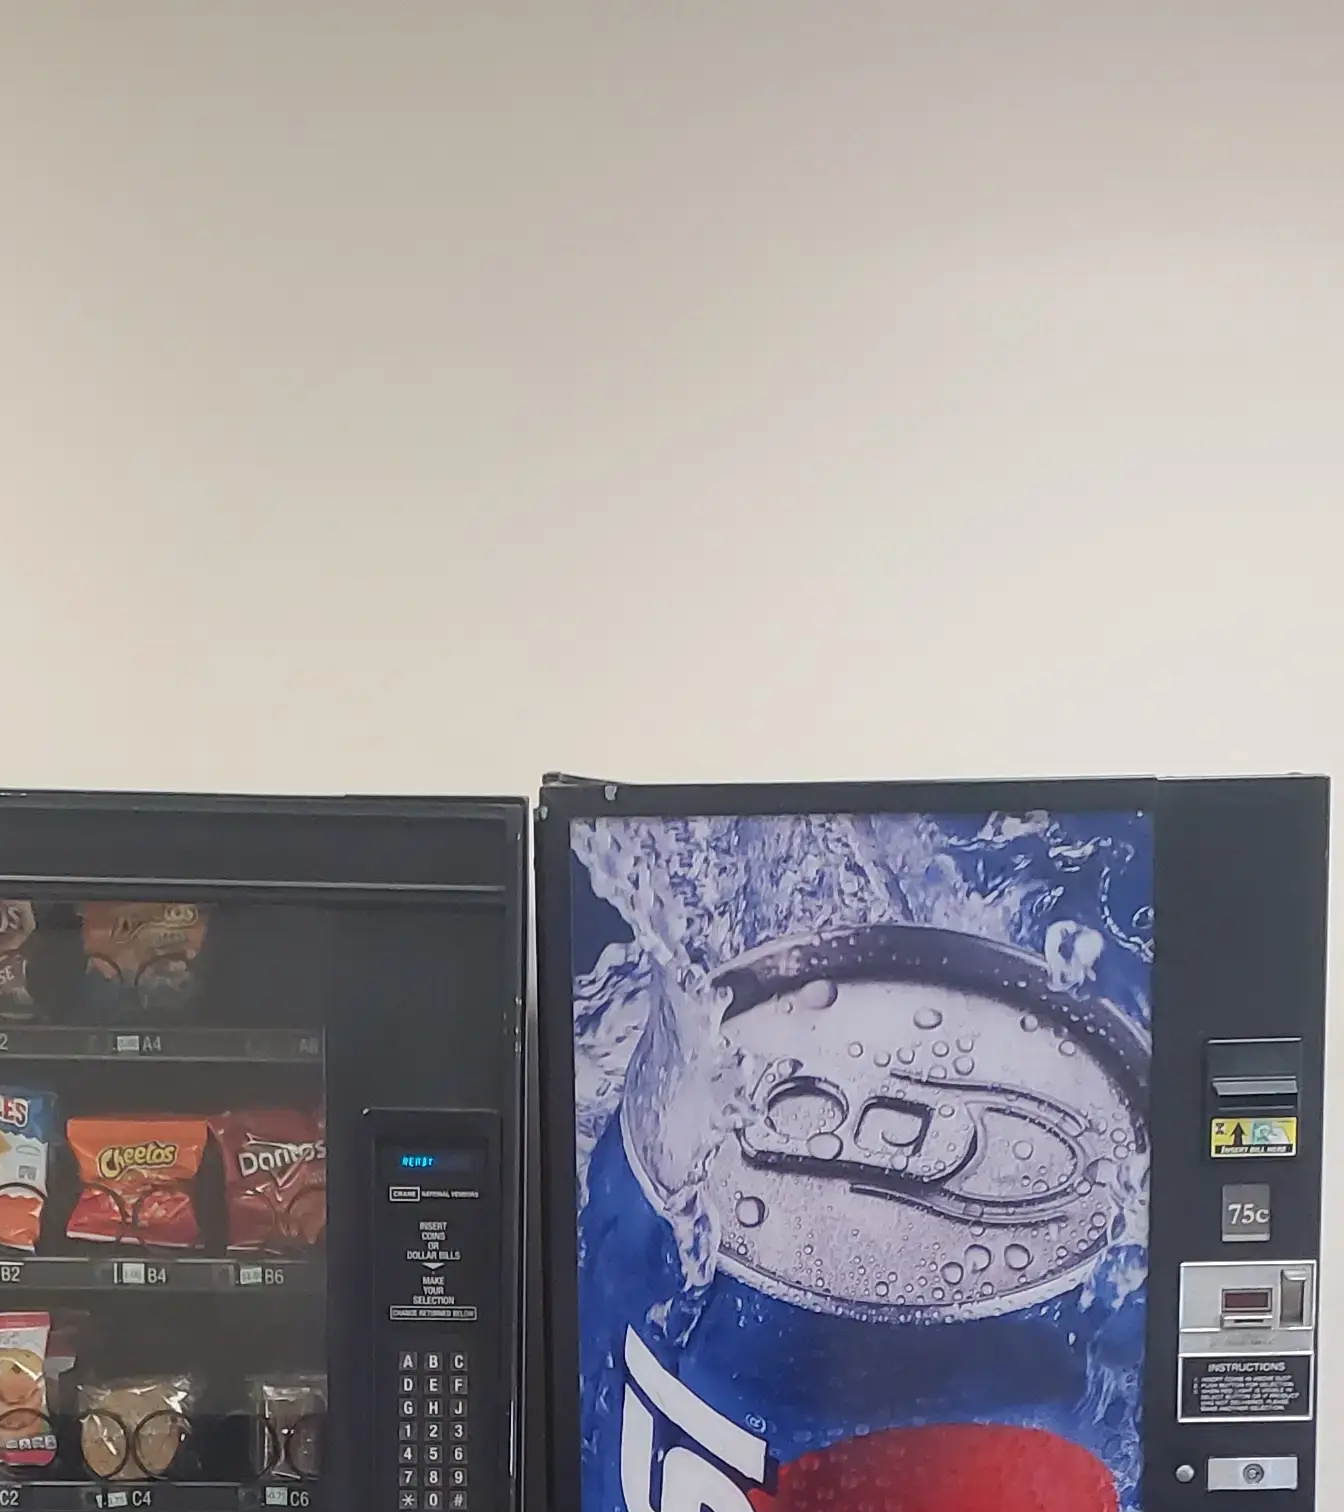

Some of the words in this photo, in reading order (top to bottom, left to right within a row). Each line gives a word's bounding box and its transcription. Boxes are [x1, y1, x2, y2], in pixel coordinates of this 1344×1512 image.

[142, 1036, 162, 1052] A4
[98, 1142, 178, 1179] Cheetos
[238, 1141, 327, 1177] Doritos
[401, 1155, 435, 1168] READY
[419, 1221, 447, 1231] INSERT
[421, 1231, 446, 1241] COINS
[427, 1241, 440, 1251] OR
[406, 1250, 437, 1261] DOLLAR
[438, 1251, 461, 1261] BILLS
[0, 1266, 21, 1282] B2
[147, 1268, 167, 1284] B4
[264, 1269, 284, 1285] B6
[422, 1276, 445, 1286] MAKE
[423, 1286, 444, 1296] YOUR
[412, 1296, 455, 1306] SELECTION
[403, 1354, 414, 1369] A
[428, 1354, 439, 1369] B
[454, 1354, 464, 1369] C
[1207, 1361, 1286, 1373] INSTRUCTIONS
[403, 1377, 414, 1392] D
[428, 1377, 439, 1392] E
[454, 1377, 464, 1392] F
[403, 1401, 414, 1415] G
[428, 1401, 439, 1415] H
[454, 1401, 464, 1415] J
[403, 1424, 414, 1438] 1
[428, 1424, 439, 1438] 2
[454, 1424, 464, 1438] 3
[403, 1447, 414, 1461] 4
[428, 1447, 439, 1461] 5
[454, 1447, 464, 1461] 6
[403, 1470, 414, 1484] 7
[428, 1470, 439, 1484] 8
[454, 1470, 464, 1484] 9
[0, 1490, 20, 1506] C2
[132, 1490, 152, 1507] C4
[290, 1491, 310, 1508] C6
[428, 1493, 439, 1507] 0
